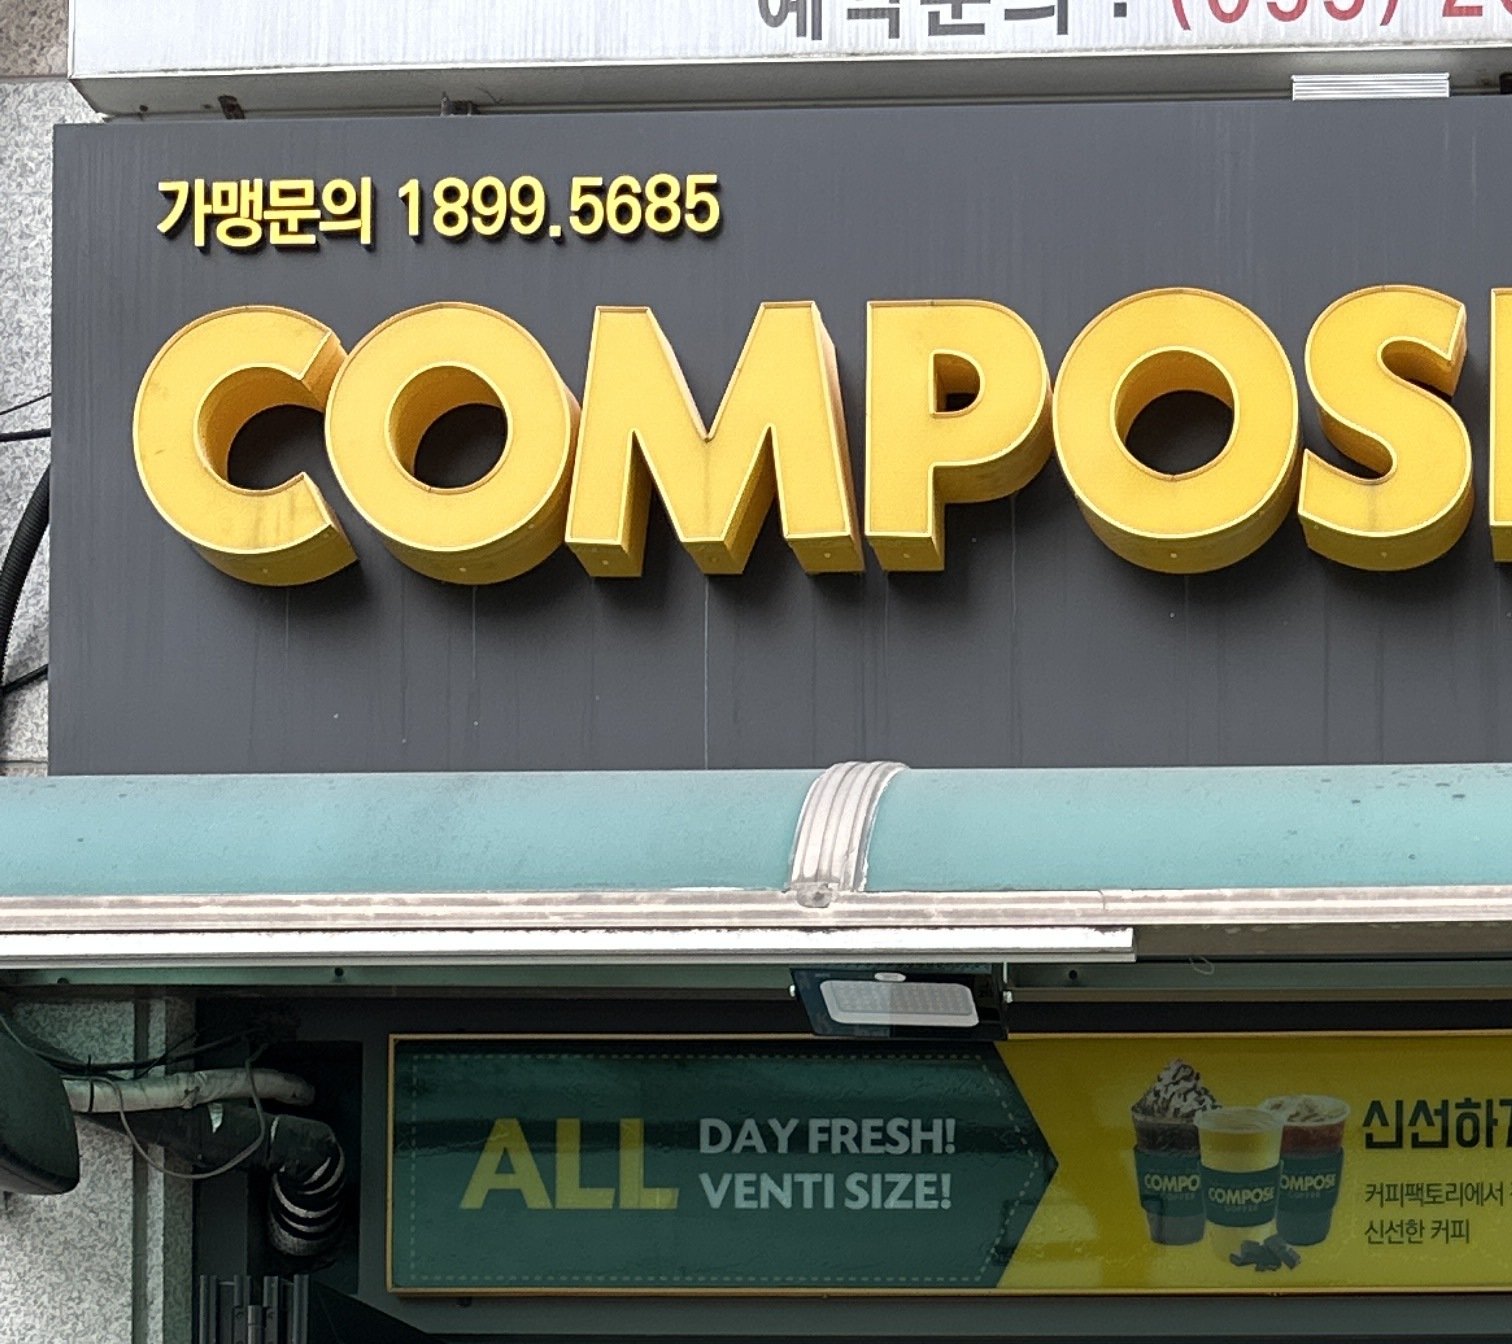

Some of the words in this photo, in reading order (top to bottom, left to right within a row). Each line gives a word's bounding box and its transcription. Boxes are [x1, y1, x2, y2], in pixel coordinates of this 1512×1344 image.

[157, 177, 373, 249] 가맹문의
[397, 173, 722, 239] 1899.5685
[700, 1117, 800, 1156] DAY
[808, 1116, 957, 1156] FRESH!
[460, 1117, 680, 1210] ALL
[699, 1172, 834, 1210] VENTI
[843, 1172, 953, 1210] SIZE!
[1144, 1173, 1200, 1192] COMPO
[1279, 1173, 1337, 1191] OMPOSE
[1363, 1180, 1505, 1207] 커피팩토리에서
[1363, 1218, 1426, 1245] 신선한
[1430, 1218, 1471, 1245] 커피
